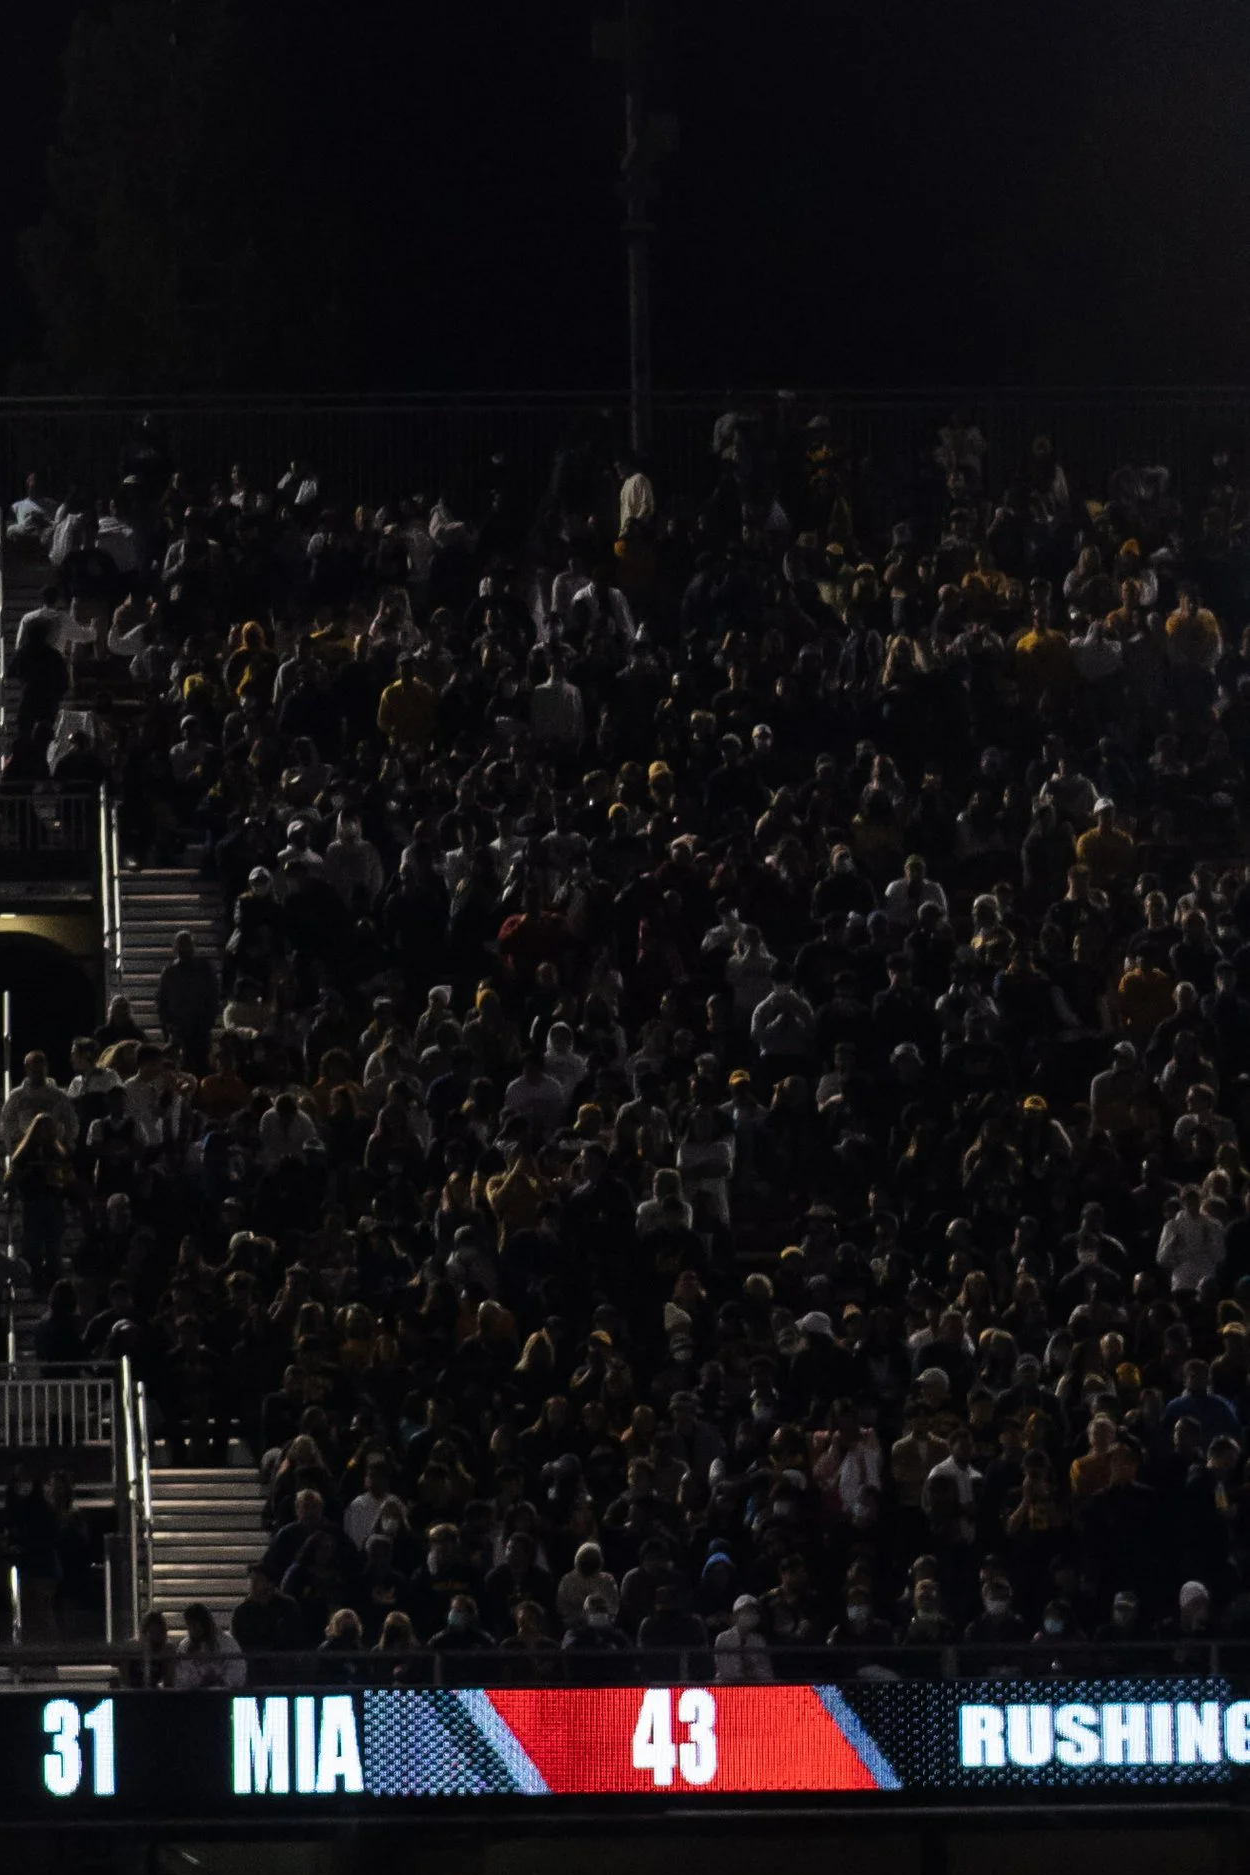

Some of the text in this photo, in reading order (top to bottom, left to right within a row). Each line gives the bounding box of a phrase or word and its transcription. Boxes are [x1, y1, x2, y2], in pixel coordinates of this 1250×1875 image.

[43, 1696, 363, 1794] 31 MIA
[632, 1688, 717, 1786] 43
